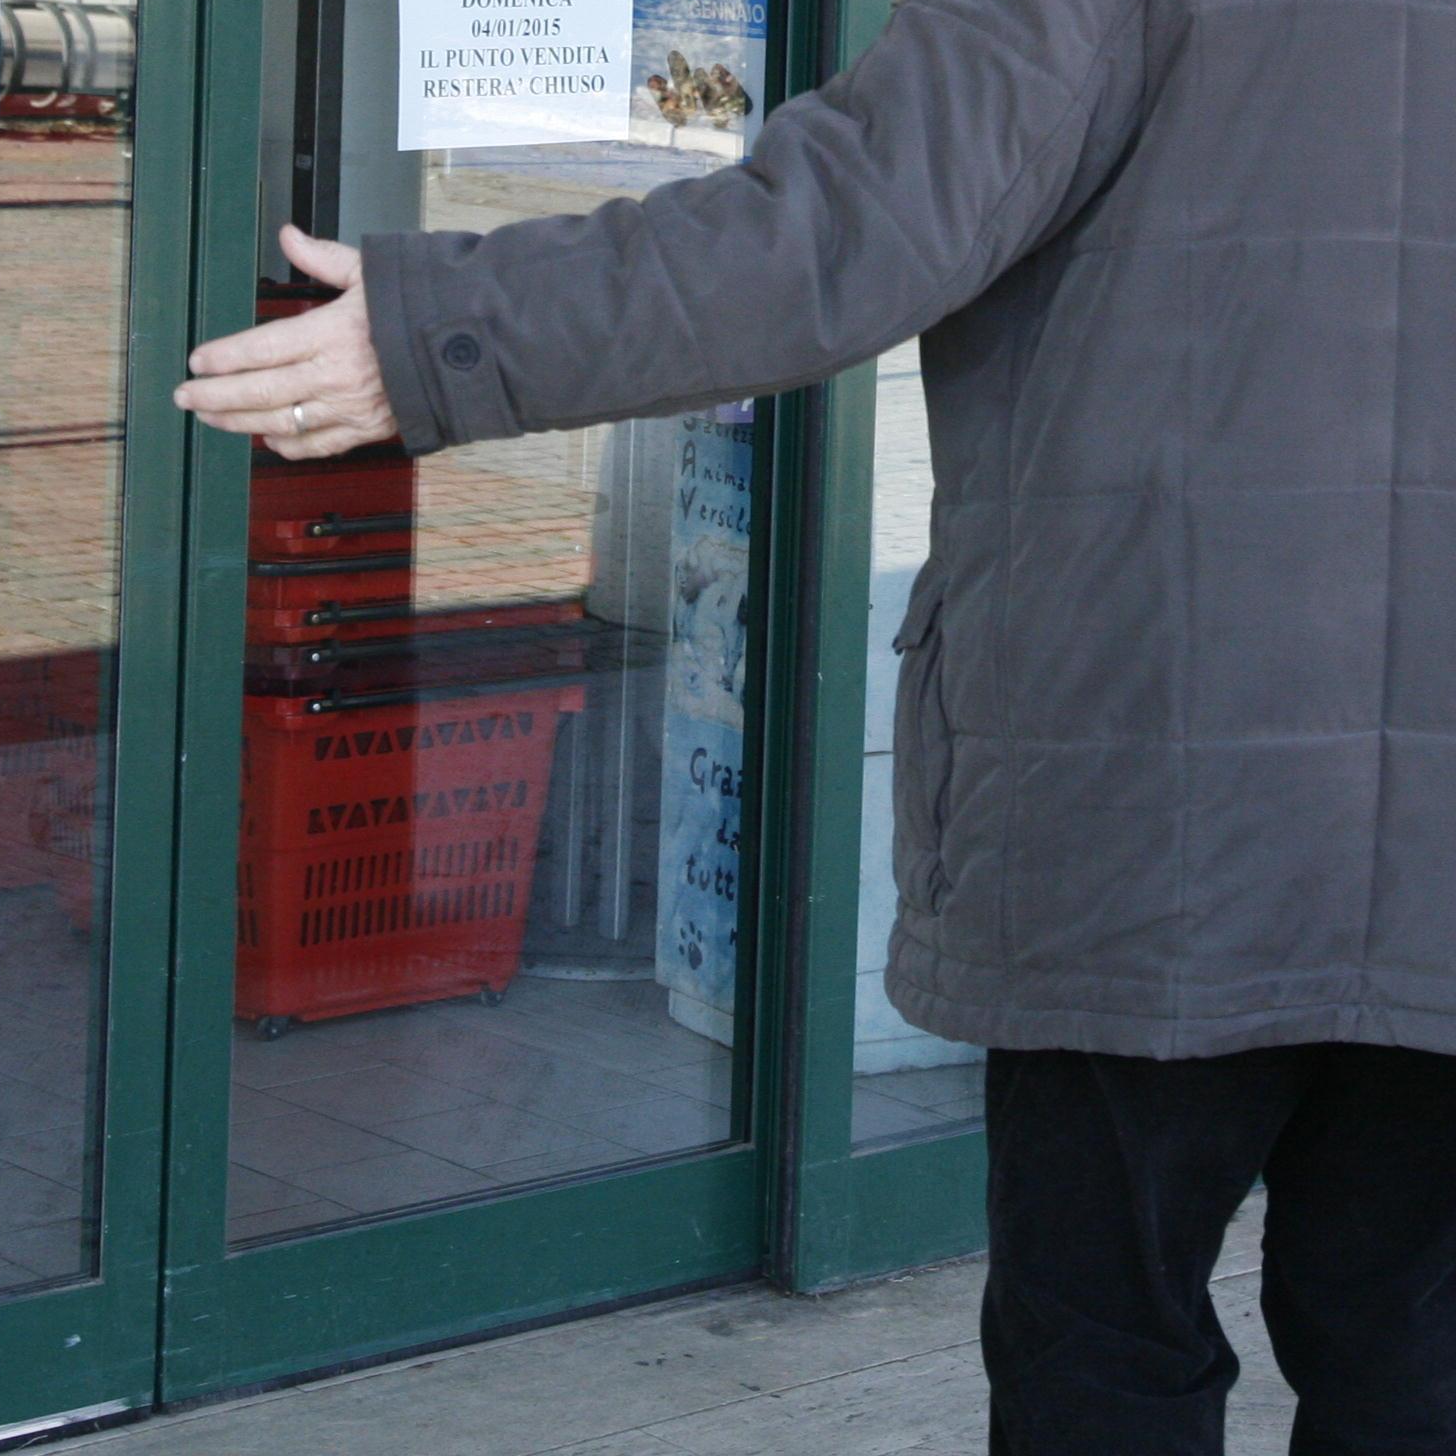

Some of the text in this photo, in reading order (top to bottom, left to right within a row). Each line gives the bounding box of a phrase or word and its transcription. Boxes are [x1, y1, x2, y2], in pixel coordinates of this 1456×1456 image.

[471, 17, 562, 38] 04/01/2015
[420, 46, 610, 69] IL PUNTO VENDITA
[529, 74, 606, 95] CHIUSO
